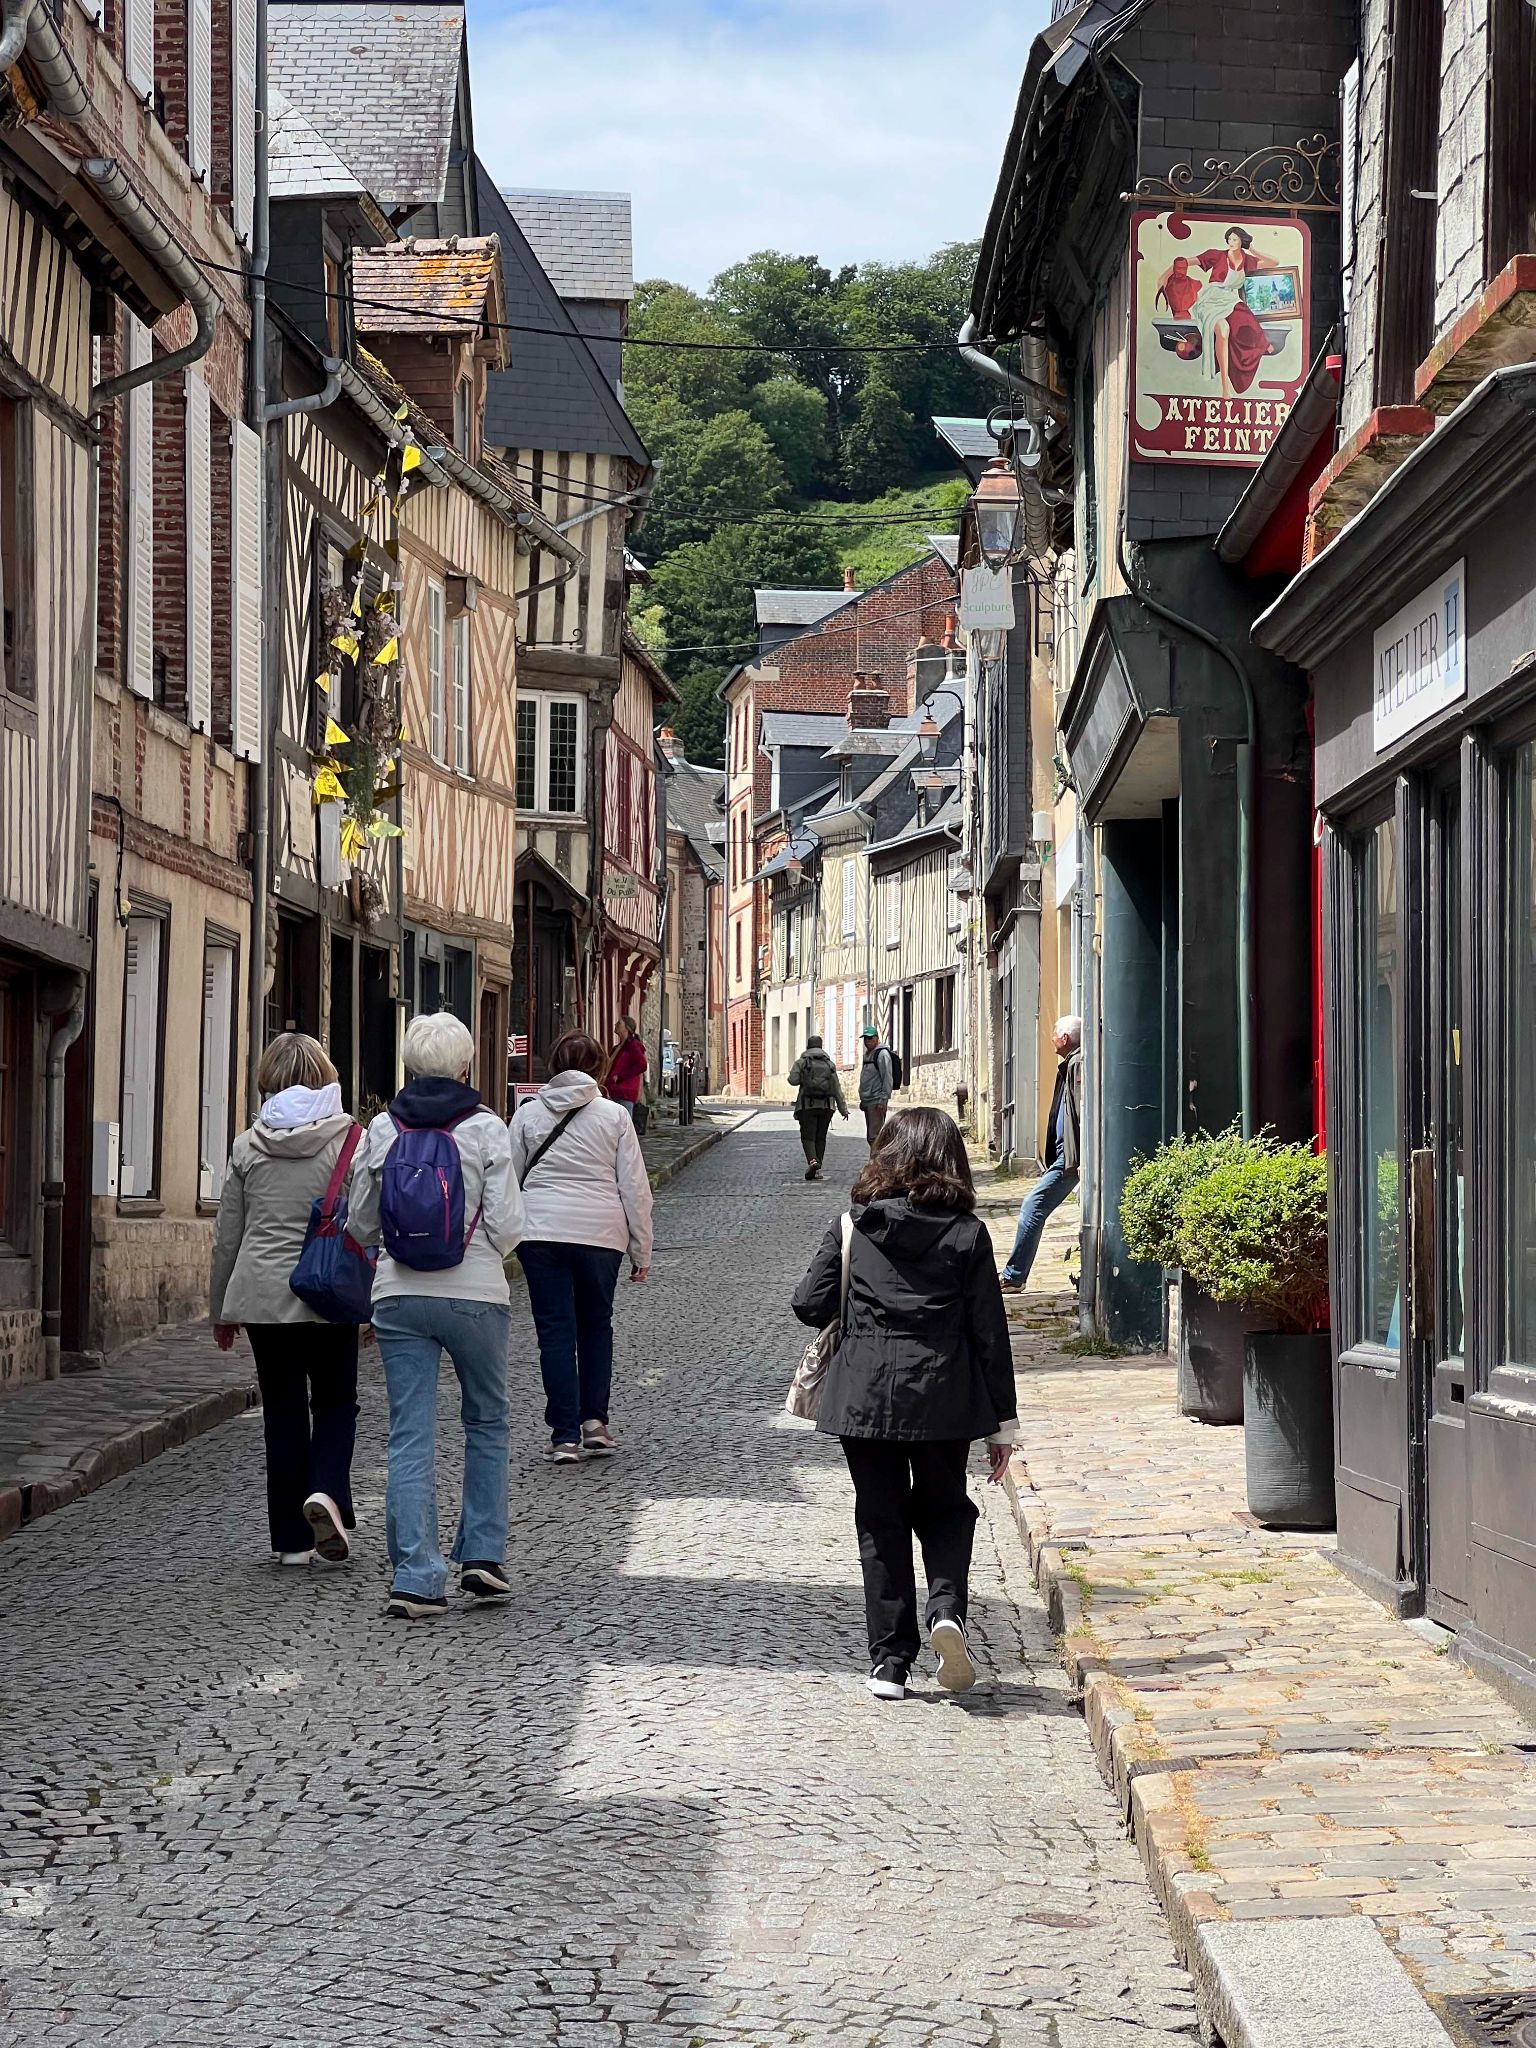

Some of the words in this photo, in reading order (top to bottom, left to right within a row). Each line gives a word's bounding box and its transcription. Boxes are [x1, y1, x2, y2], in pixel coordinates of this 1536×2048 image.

[1165, 398, 1292, 426] ATELIER
[1184, 426, 1274, 453] FEINT
[963, 601, 1012, 615] Sculpture
[1376, 611, 1441, 722] ATELIER
[1445, 592, 1459, 673] H
